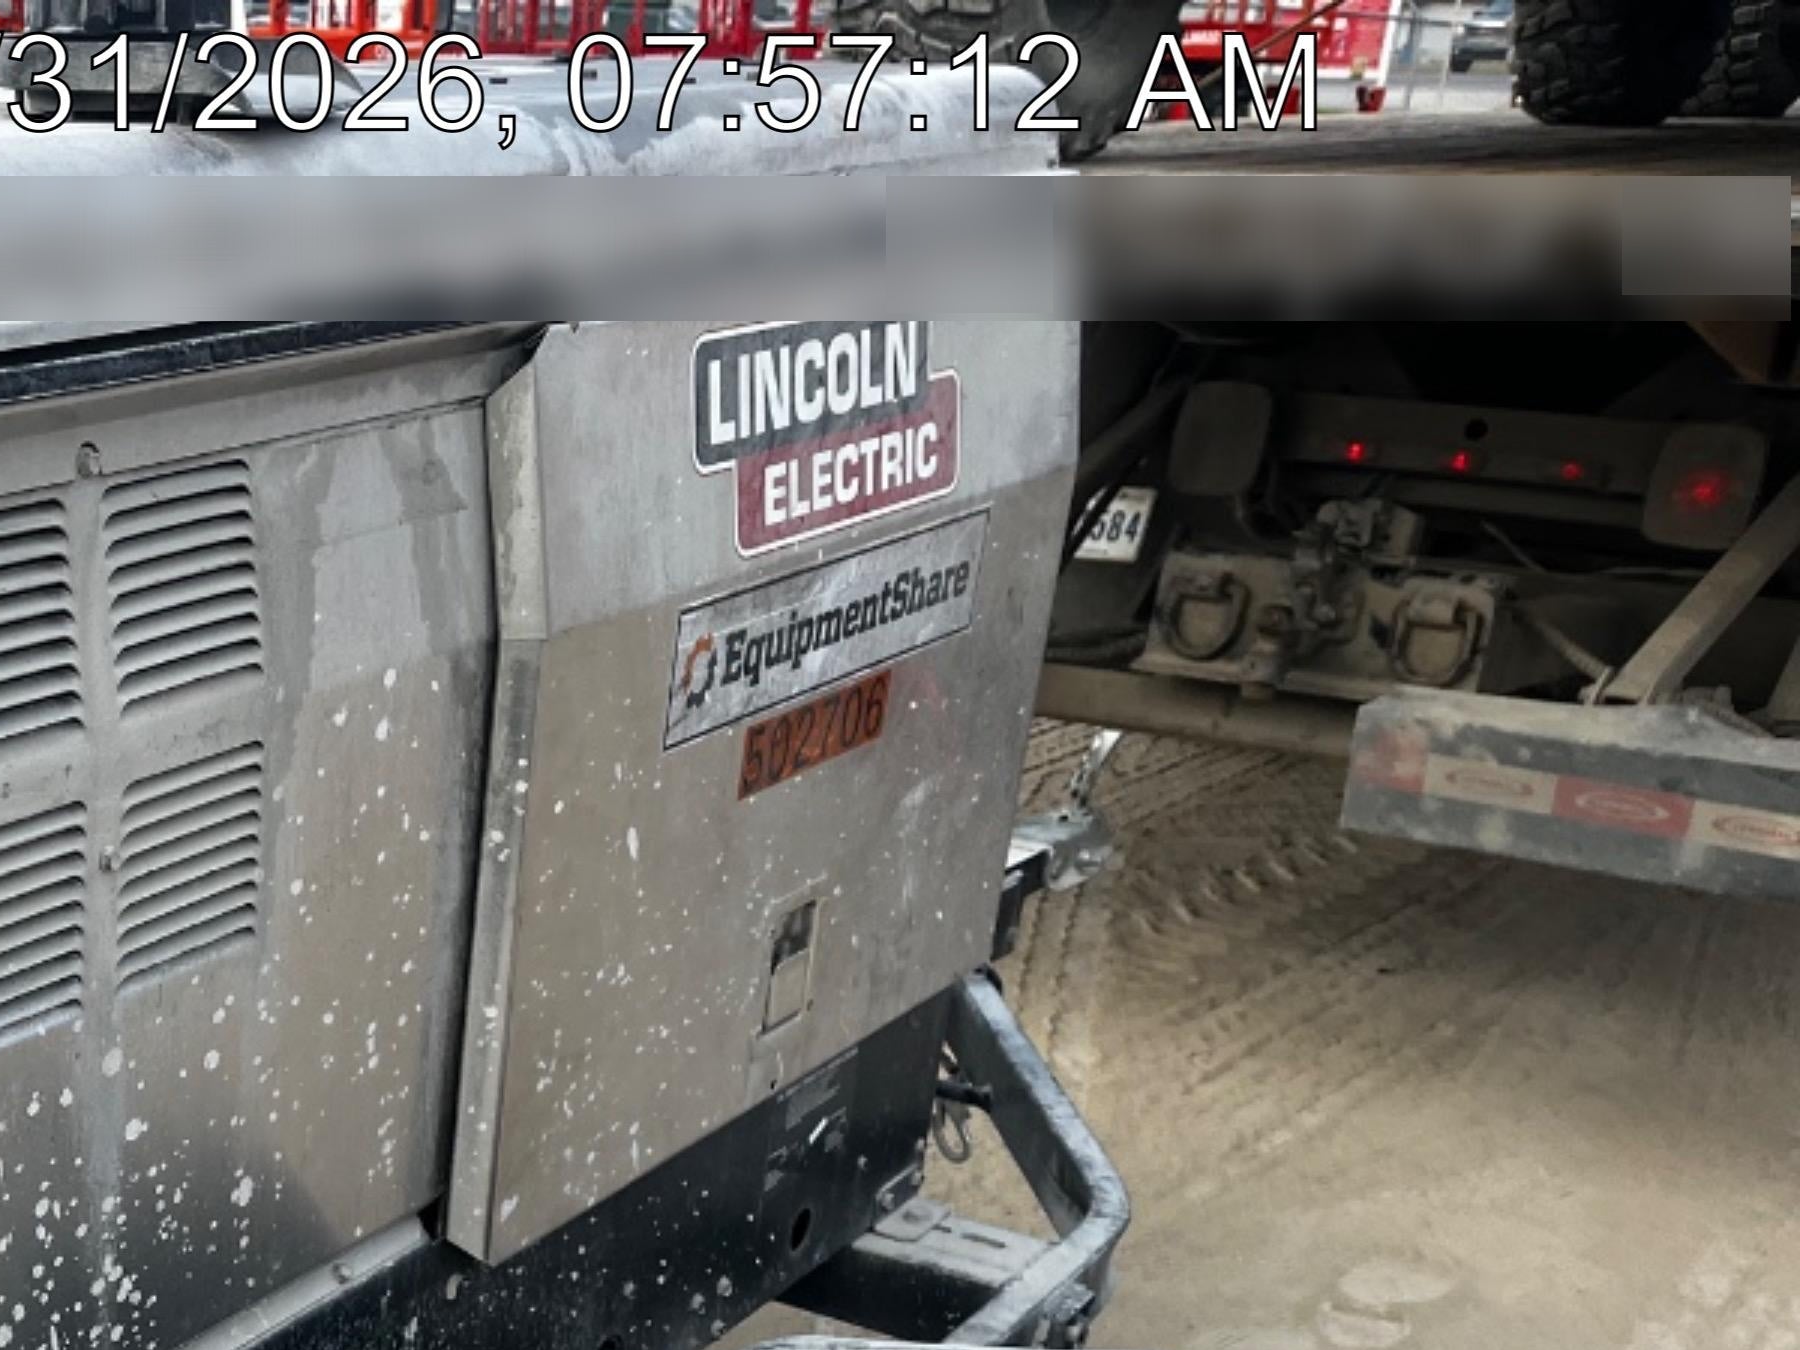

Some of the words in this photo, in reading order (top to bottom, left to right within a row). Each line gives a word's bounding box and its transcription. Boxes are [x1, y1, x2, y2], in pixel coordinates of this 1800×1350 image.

[707, 322, 917, 446] LINCOLN
[763, 421, 940, 527] ELECTRIC
[720, 560, 970, 688] EquipmentShare
[742, 675, 890, 793] 502706
